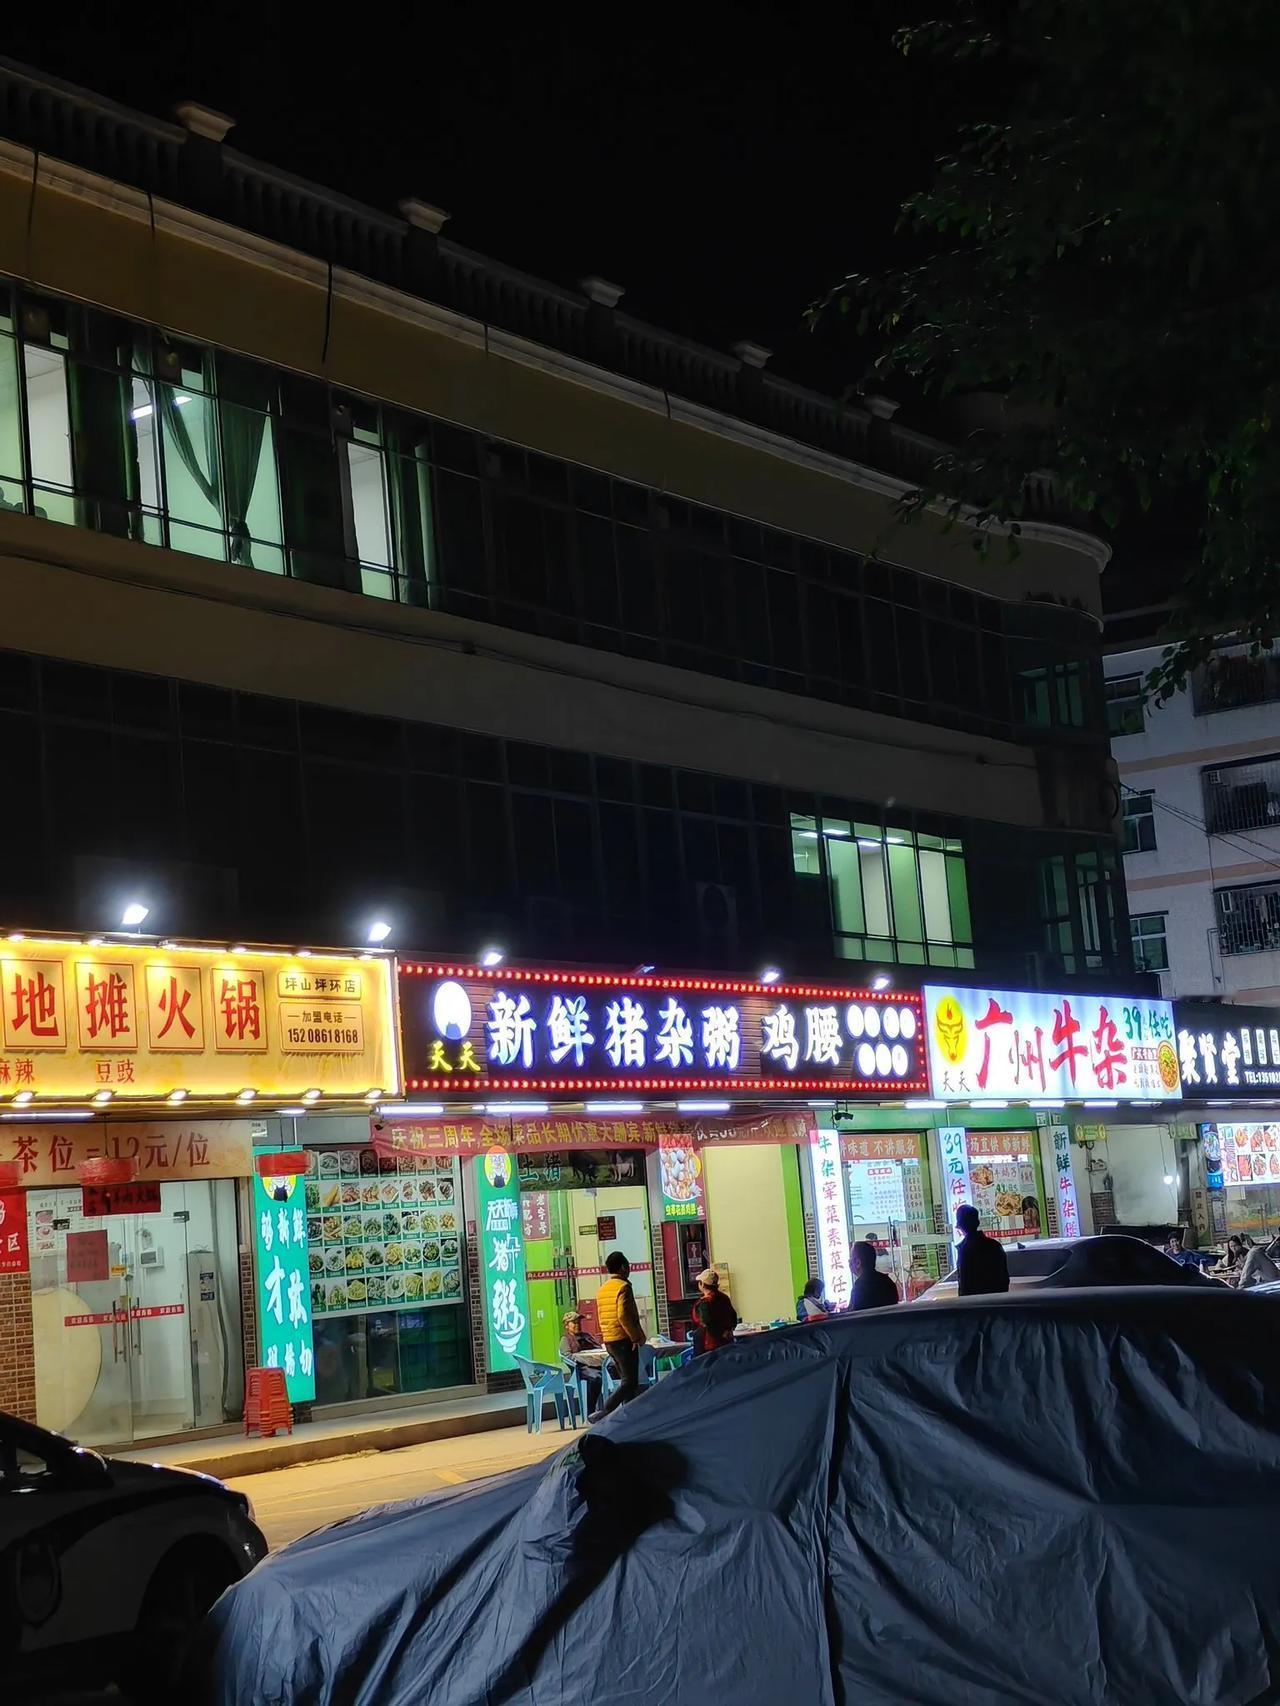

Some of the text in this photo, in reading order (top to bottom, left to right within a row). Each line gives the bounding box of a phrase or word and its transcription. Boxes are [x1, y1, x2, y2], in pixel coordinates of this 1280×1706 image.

[284, 976, 356, 993] 坪山坪环店
[11, 970, 262, 1041] 地摊火锅
[302, 1009, 344, 1024] 加盟电话
[287, 1027, 359, 1044] 15208618168
[486, 991, 741, 1070] 新鲜猪杂粥
[761, 1004, 844, 1071] 鸡腰
[975, 998, 1127, 1092] 广州牛杂
[95, 1058, 136, 1084] 豆豉
[427, 1040, 482, 1073] 天天
[942, 1070, 972, 1093] 天天
[818, 1134, 849, 1311] 牛杂荤菜素菜任
